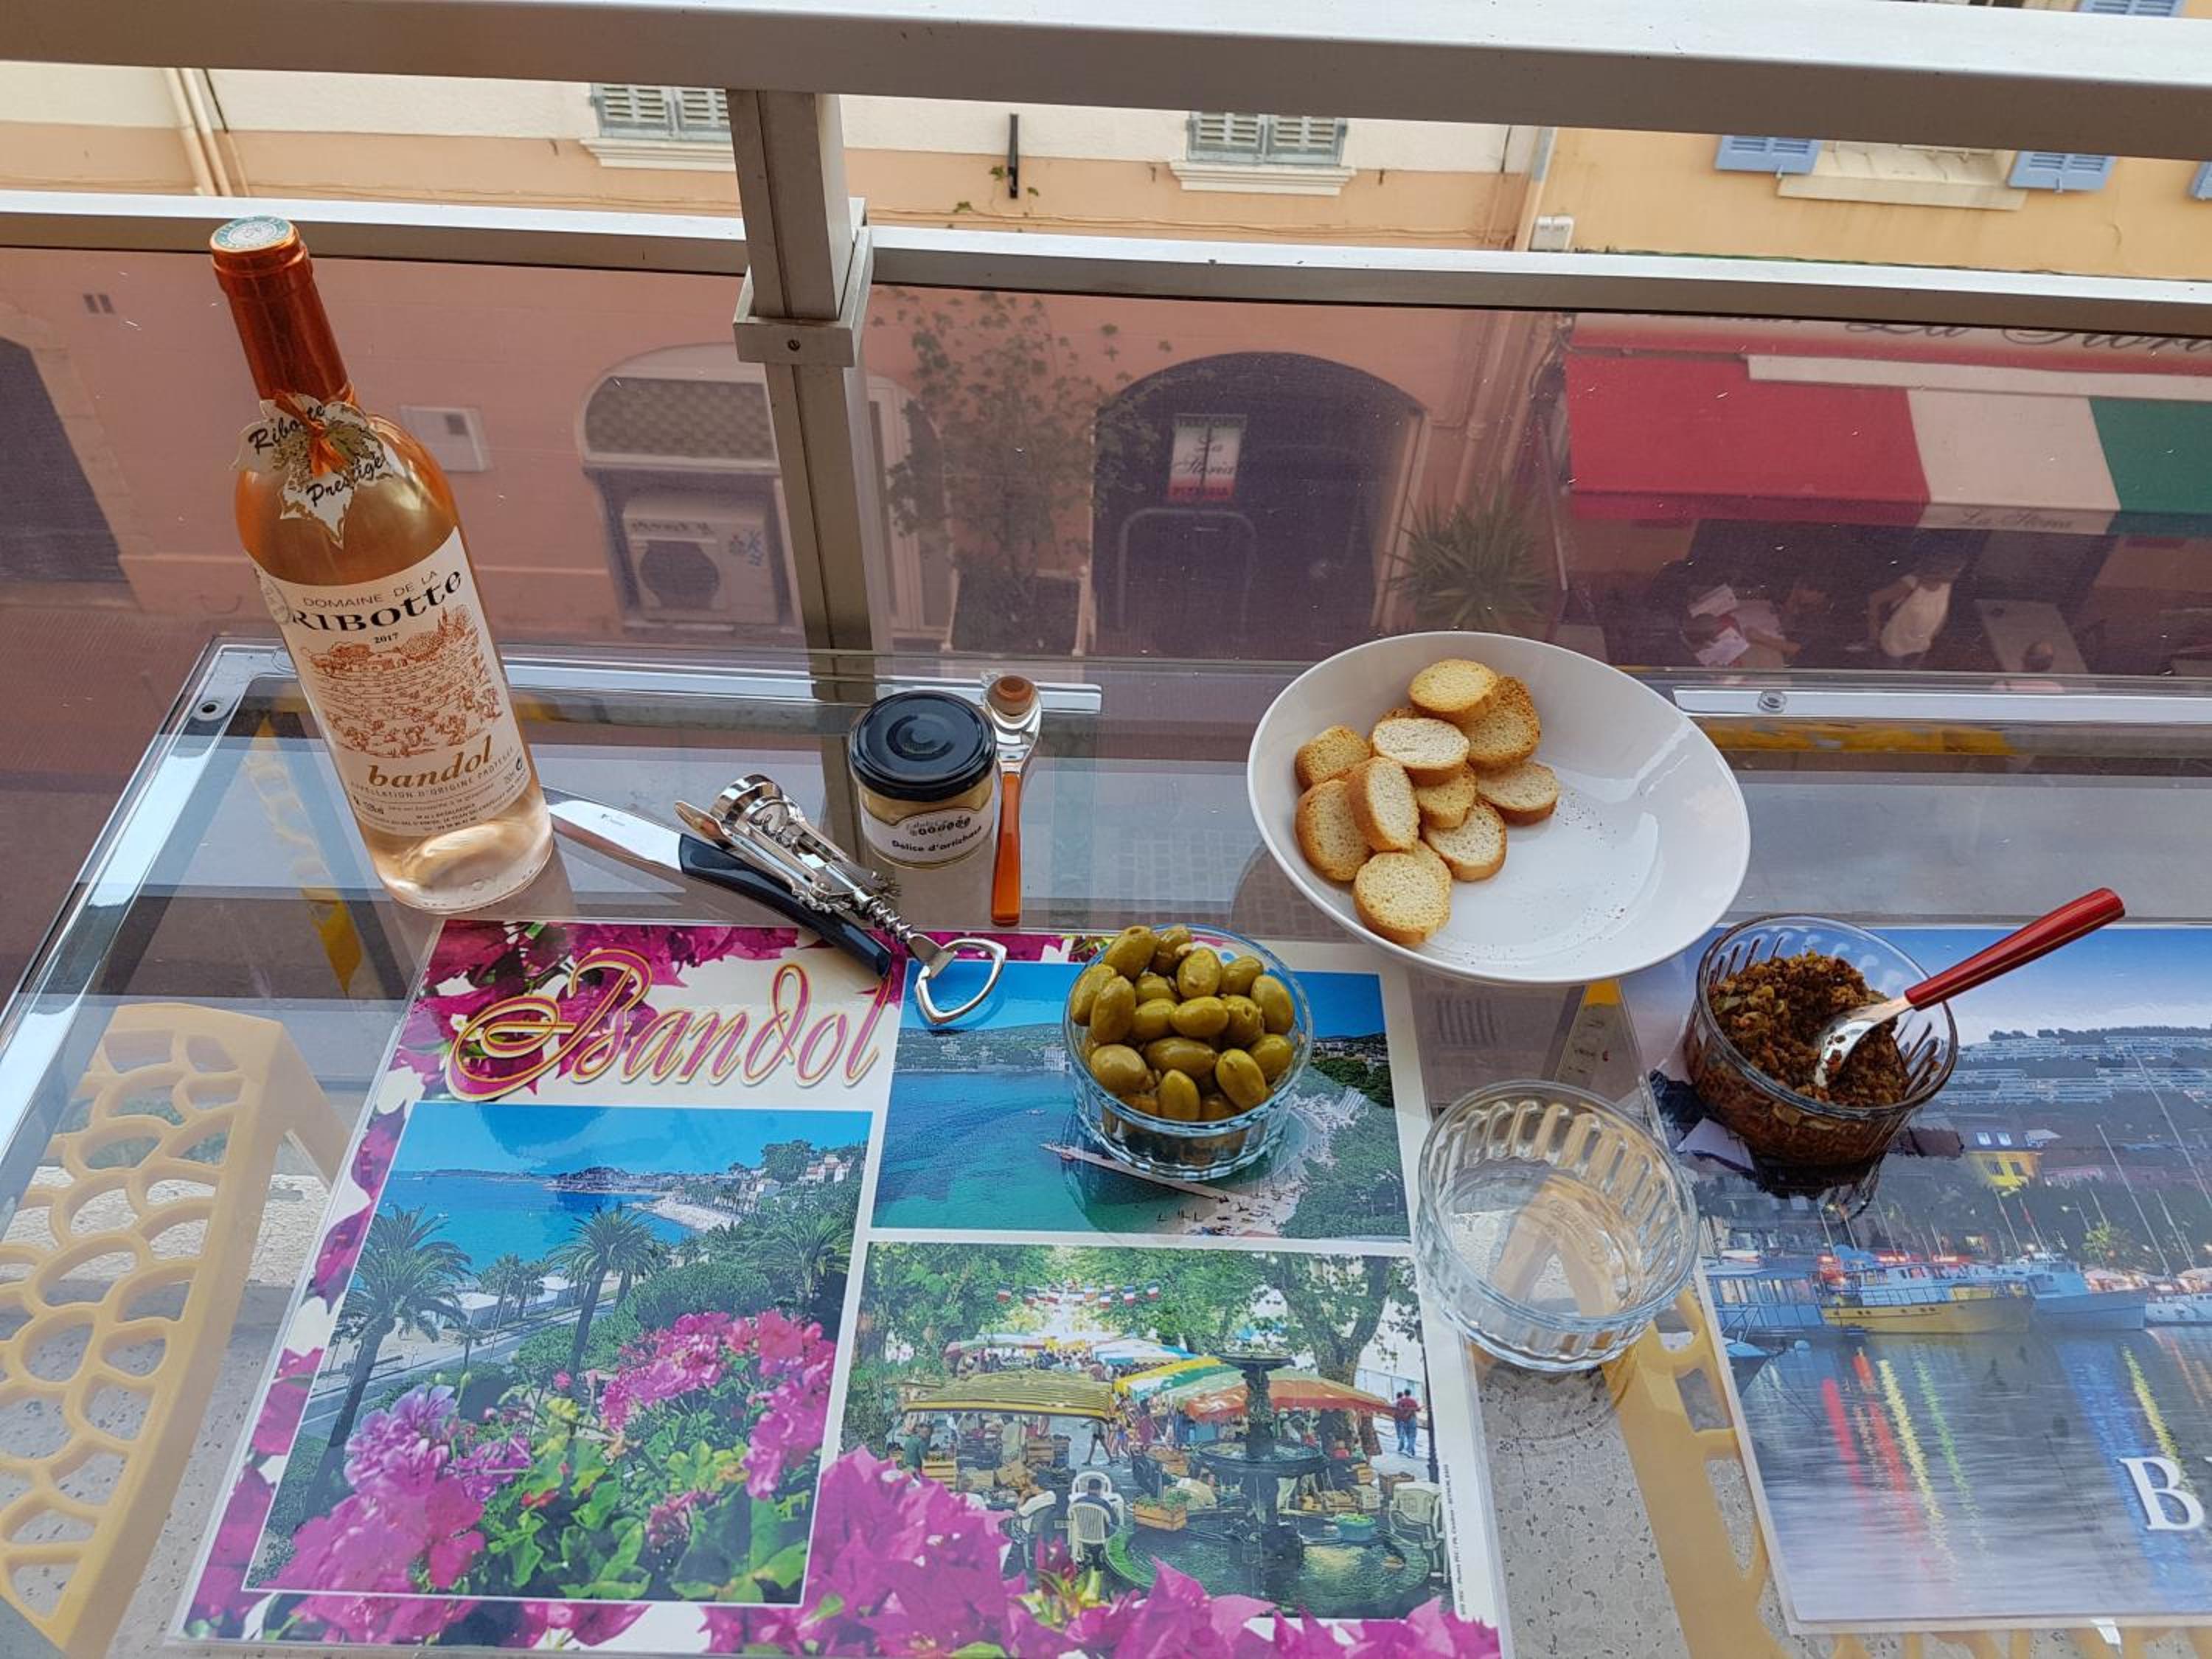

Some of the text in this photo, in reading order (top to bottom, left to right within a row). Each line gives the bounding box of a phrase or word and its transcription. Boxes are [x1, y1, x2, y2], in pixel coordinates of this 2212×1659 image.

[302, 570, 438, 608] DOMAINE DE LA
[374, 632, 400, 644] 2017
[369, 734, 492, 789] bandol
[444, 947, 892, 1100] Bandol
[2118, 1456, 2212, 1531] B
